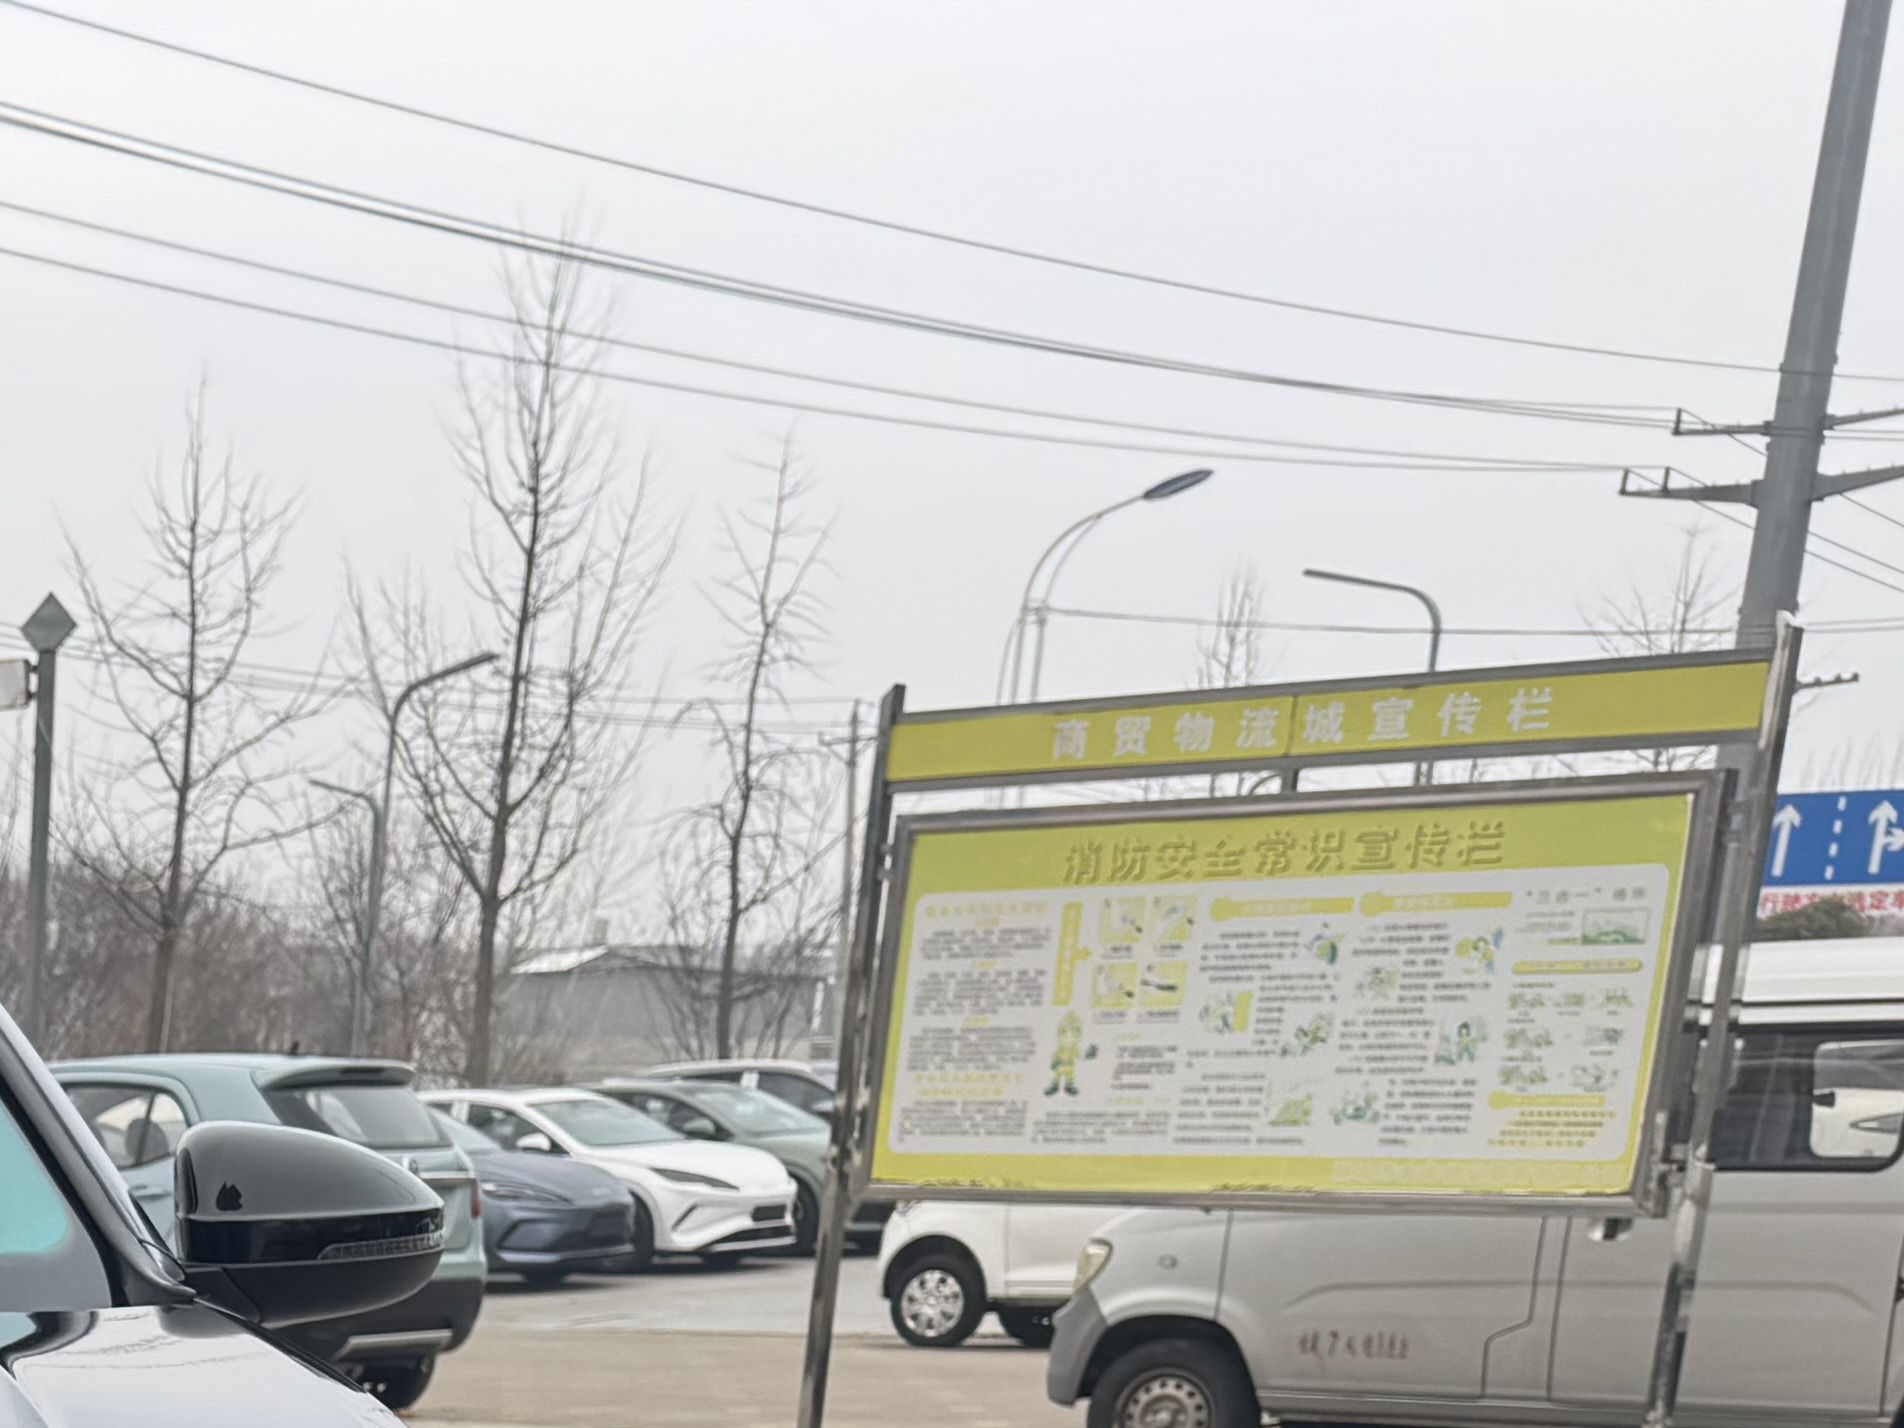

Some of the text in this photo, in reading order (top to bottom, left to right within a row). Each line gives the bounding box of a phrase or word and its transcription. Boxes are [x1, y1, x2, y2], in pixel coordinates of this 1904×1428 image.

[1052, 686, 1554, 761] 商贸物流城宣传栏
[1062, 820, 1507, 885] 消防安全常识宣传栏
